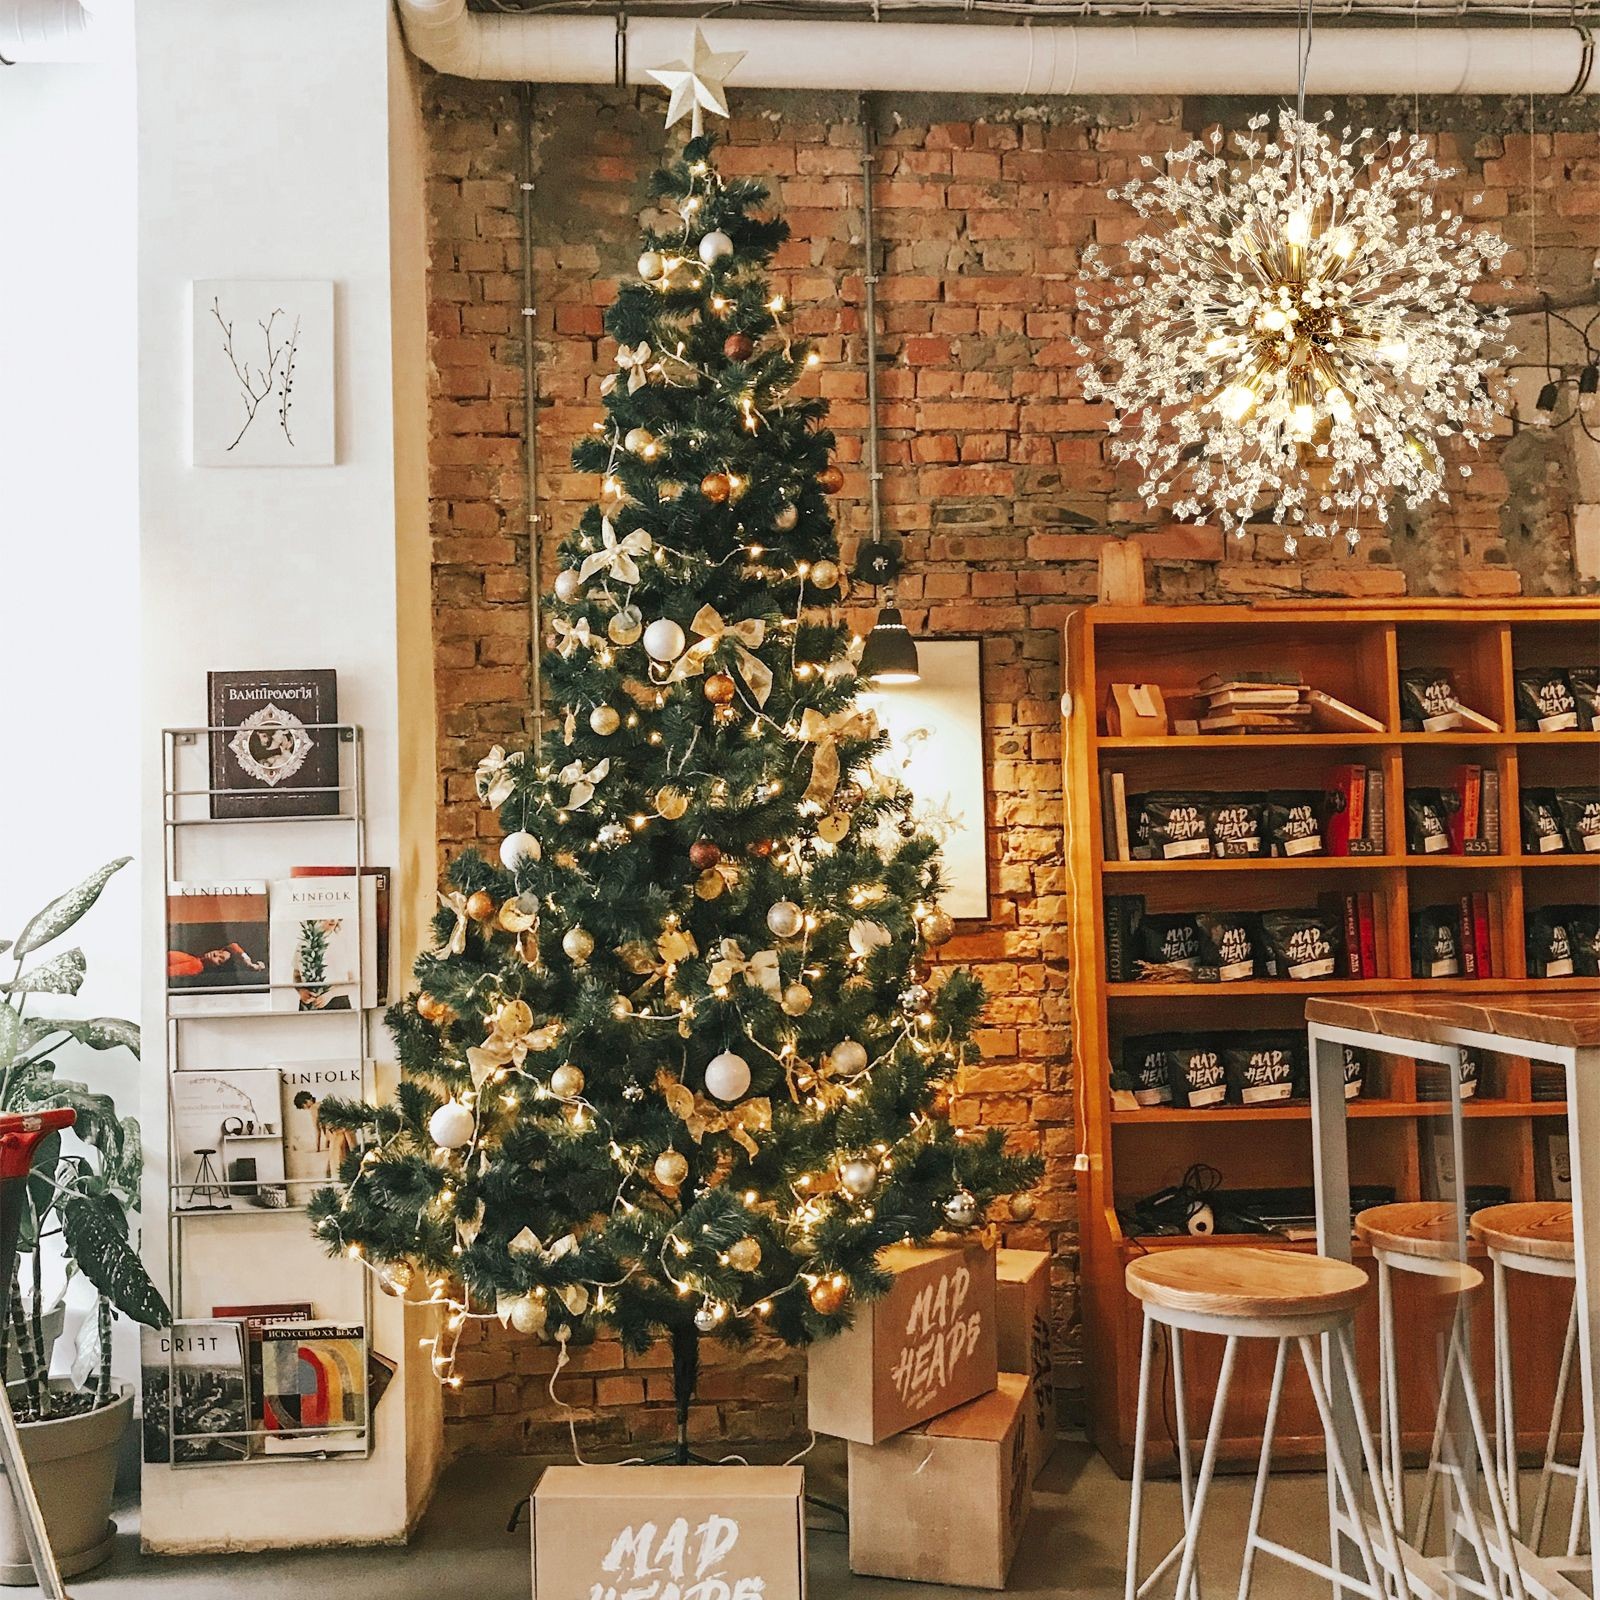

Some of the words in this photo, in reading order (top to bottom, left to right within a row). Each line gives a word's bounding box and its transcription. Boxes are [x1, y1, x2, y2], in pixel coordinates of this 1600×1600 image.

[1540, 684, 1566, 699] MAD
[1169, 807, 1197, 821] MAD
[1218, 808, 1248, 823] MAD
[1164, 820, 1205, 838] HEADS
[1214, 820, 1257, 838] HEADS
[181, 886, 253, 898] KINFOLK
[292, 891, 351, 902] KINFOLK
[1166, 927, 1193, 942] MAD
[1223, 927, 1246, 944] MAD
[1290, 928, 1320, 945] MAD
[1286, 941, 1330, 960] HEADS
[1190, 1052, 1217, 1069] MAD
[1250, 1050, 1283, 1066] MAD
[280, 1069, 360, 1085] KINFOLK
[1186, 1066, 1224, 1086] HEADS
[1244, 1064, 1290, 1085] HEADS
[906, 1266, 970, 1336] MAD
[268, 1329, 320, 1338] ИСКУССТВО
[336, 1328, 359, 1336] ВЕКА
[890, 1311, 981, 1402] HEADS
[602, 1514, 741, 1582] MAD
